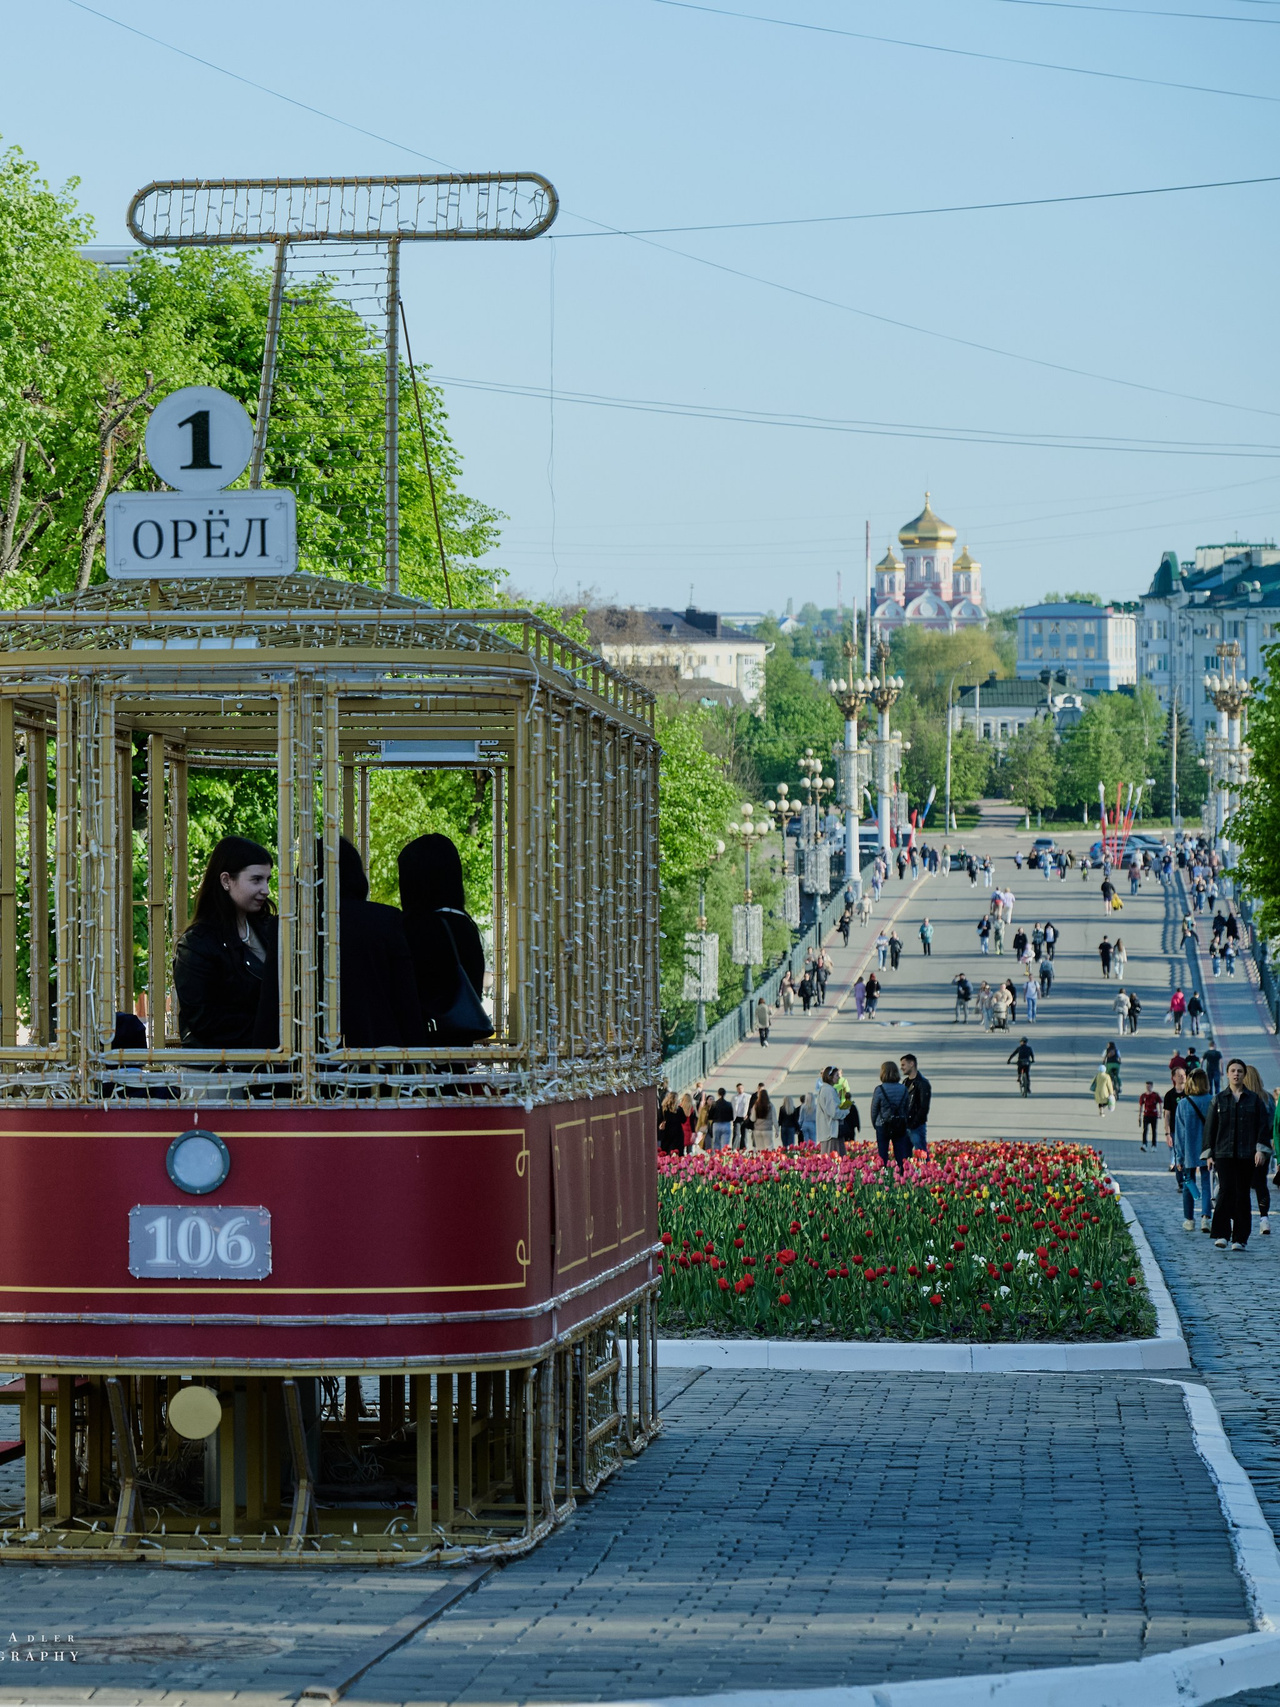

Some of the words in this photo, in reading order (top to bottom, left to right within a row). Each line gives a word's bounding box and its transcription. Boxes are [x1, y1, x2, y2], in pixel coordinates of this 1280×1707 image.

[177, 410, 223, 470] 1
[132, 509, 269, 559] ОРЁЛ
[144, 1215, 256, 1269] 106
